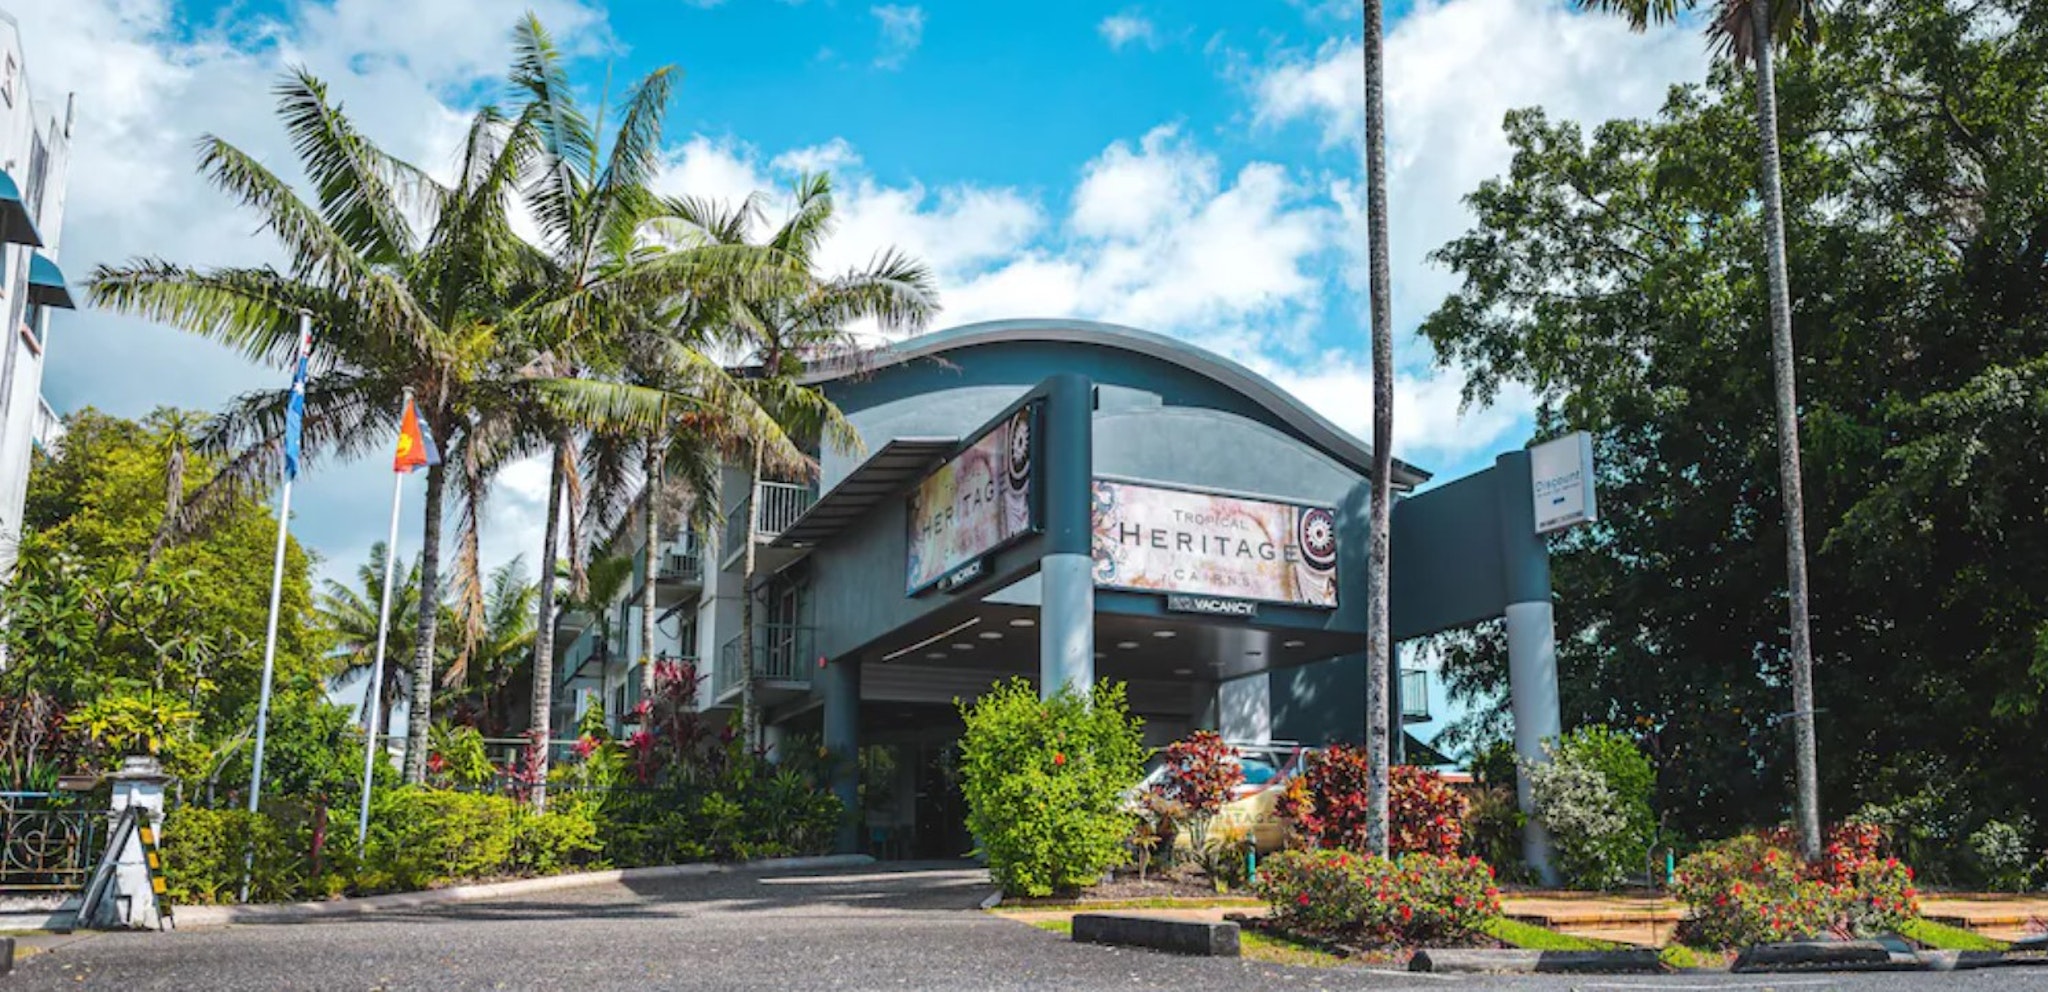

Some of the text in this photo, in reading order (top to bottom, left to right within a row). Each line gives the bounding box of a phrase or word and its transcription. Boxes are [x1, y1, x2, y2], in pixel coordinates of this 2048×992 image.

[1174, 509, 1249, 530] TROPICAL
[1119, 522, 1300, 563] HERITAGE
[1194, 598, 1253, 614] VACANCY
